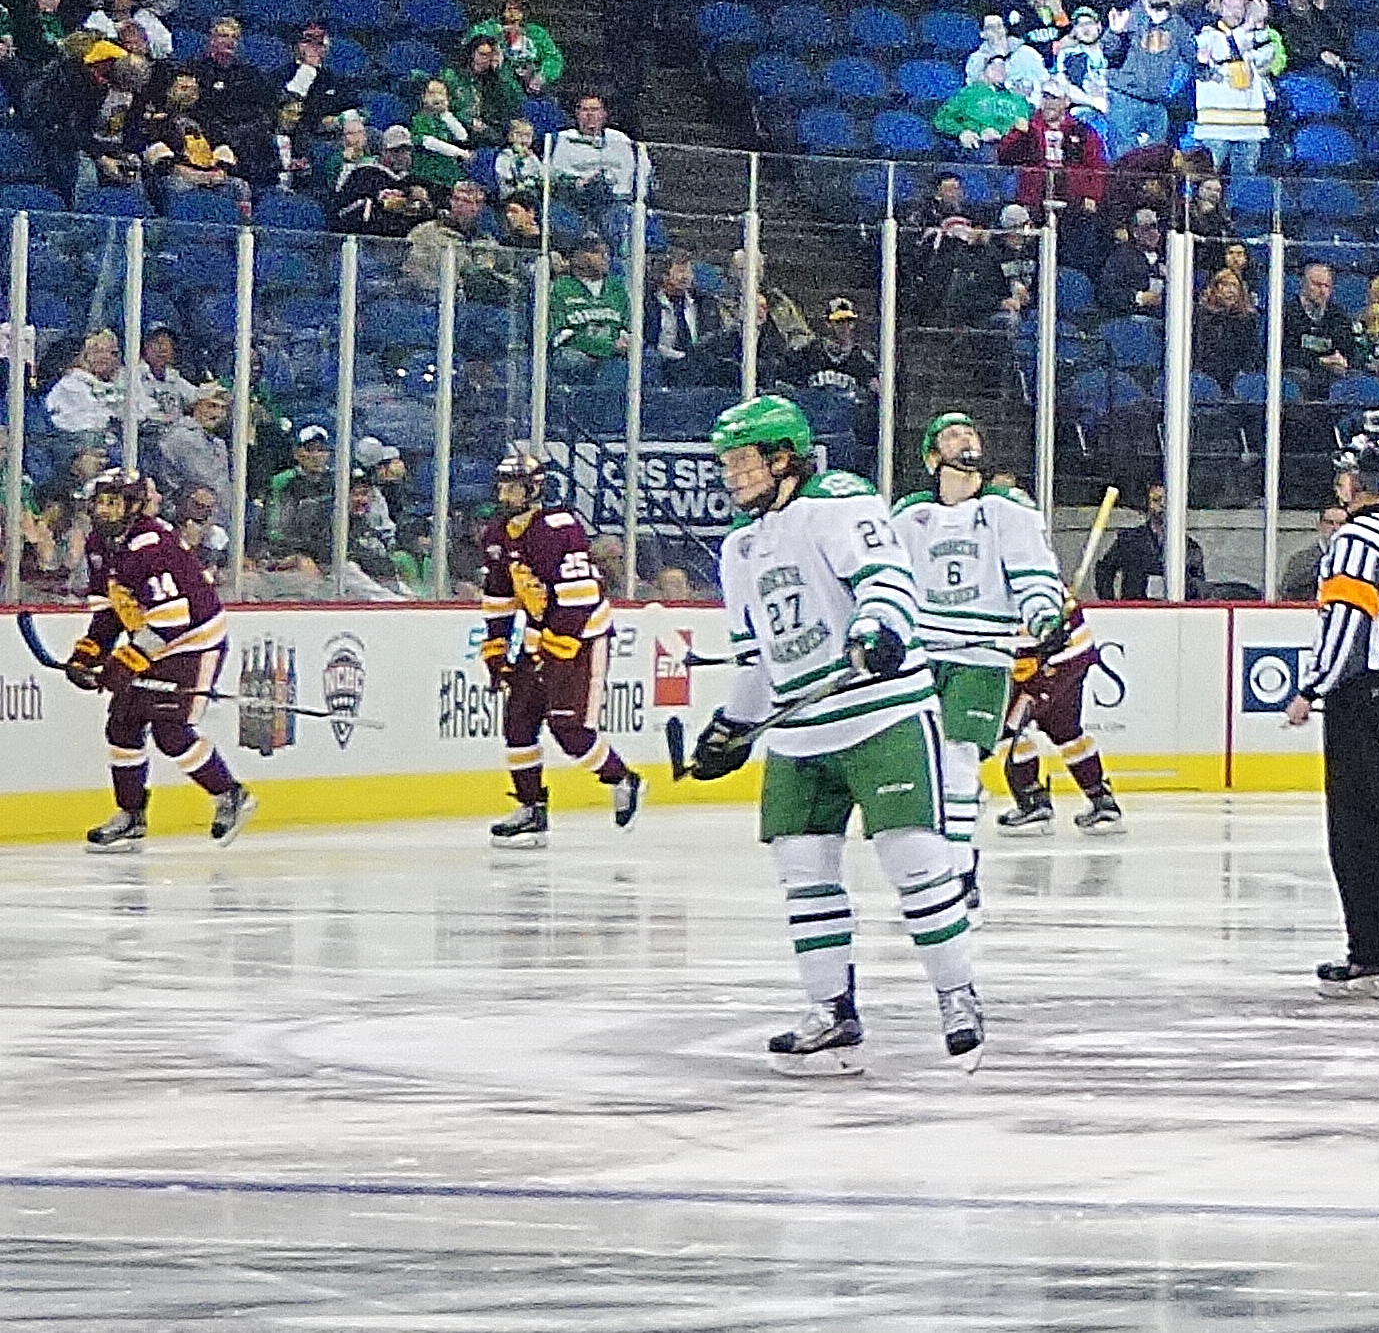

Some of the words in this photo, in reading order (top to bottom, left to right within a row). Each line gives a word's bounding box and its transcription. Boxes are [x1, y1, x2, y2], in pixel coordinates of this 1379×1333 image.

[601, 489, 734, 518] NETWO
[973, 506, 988, 531] A
[560, 551, 590, 579] 25
[947, 561, 962, 586] 6
[766, 593, 803, 636] 27
